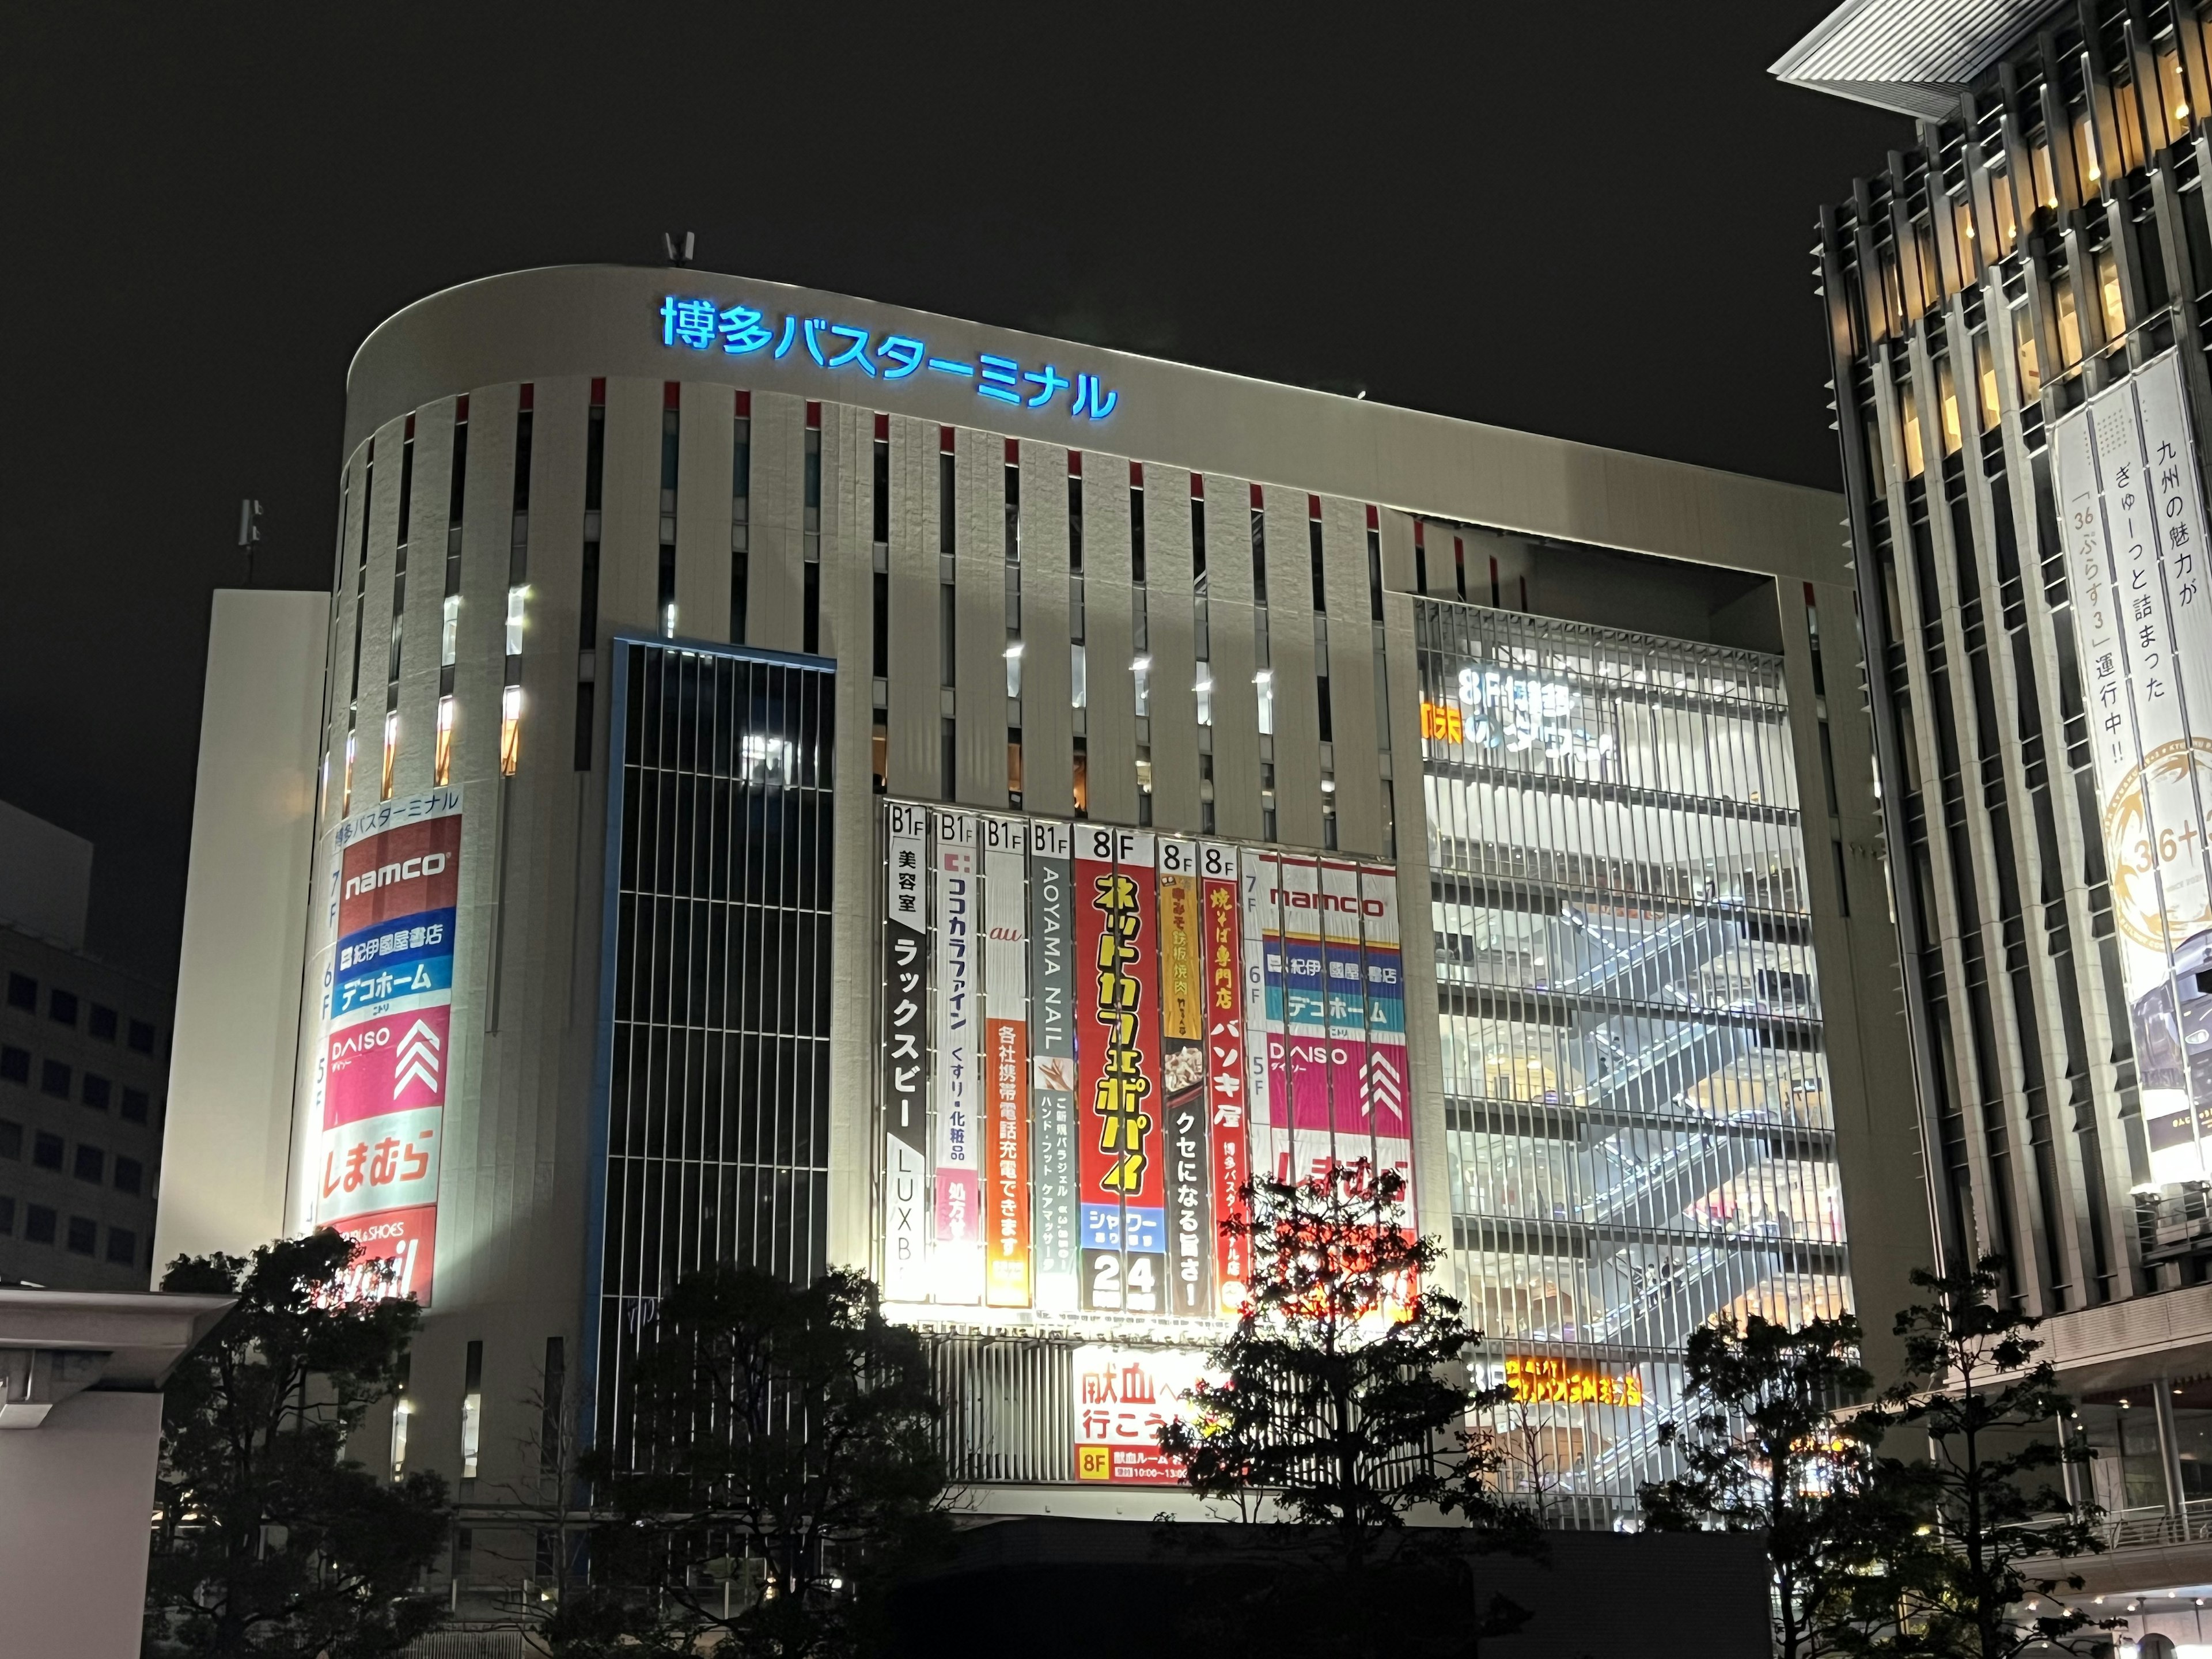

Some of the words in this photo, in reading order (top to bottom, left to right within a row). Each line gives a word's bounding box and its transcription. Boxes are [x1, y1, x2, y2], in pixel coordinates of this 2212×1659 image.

[660, 296, 1118, 421] 博多バスターミナル
[2157, 440, 2196, 607] 九州の魅力が
[2116, 462, 2165, 702] ぎゅーっと詰まった
[334, 792, 459, 851] 博多バスターミナル
[893, 806, 924, 836] B1F
[942, 815, 973, 843] B1F
[988, 820, 1022, 850] B1F
[1035, 825, 1067, 854] B1F
[1094, 832, 1134, 861] 8F
[1164, 844, 1192, 872] 8F
[1206, 849, 1234, 876] 8F
[345, 853, 446, 900] namco
[898, 850, 916, 913] 美容室
[1246, 876, 1256, 913] 7F
[1043, 866, 1062, 976] AOYAMA
[1270, 888, 1384, 917] namco
[352, 924, 443, 967] 紀伊國屋書店
[949, 878, 967, 1030] ココカラファイン
[989, 927, 1023, 942] au
[1211, 888, 1232, 1010] 焼そば専門店
[342, 964, 431, 1012] デコホーム
[1249, 966, 1261, 1004] 6F
[1291, 958, 1397, 984] 紀伊國屋書店
[1044, 986, 1062, 1050] NAIL
[1289, 996, 1387, 1024] デコホーム
[332, 1027, 390, 1060] DAISO
[891, 939, 921, 1127] ラックスビー
[1093, 875, 1152, 1196] ネットカフェポパイ
[1270, 1043, 1347, 1065] DAISO
[1253, 1056, 1264, 1096] 5F
[950, 1047, 965, 1161] くすり・化粧品
[998, 1025, 1018, 1256] 各社携帯電話充電できます
[323, 1130, 433, 1199] しまむら
[1089, 1211, 1157, 1232] シャワー
[1224, 1142, 1240, 1276] 博多バスターナル店
[1093, 1255, 1156, 1293] 24
[1082, 1362, 1180, 1404] 献血へ
[1084, 1454, 1105, 1472] 8F
